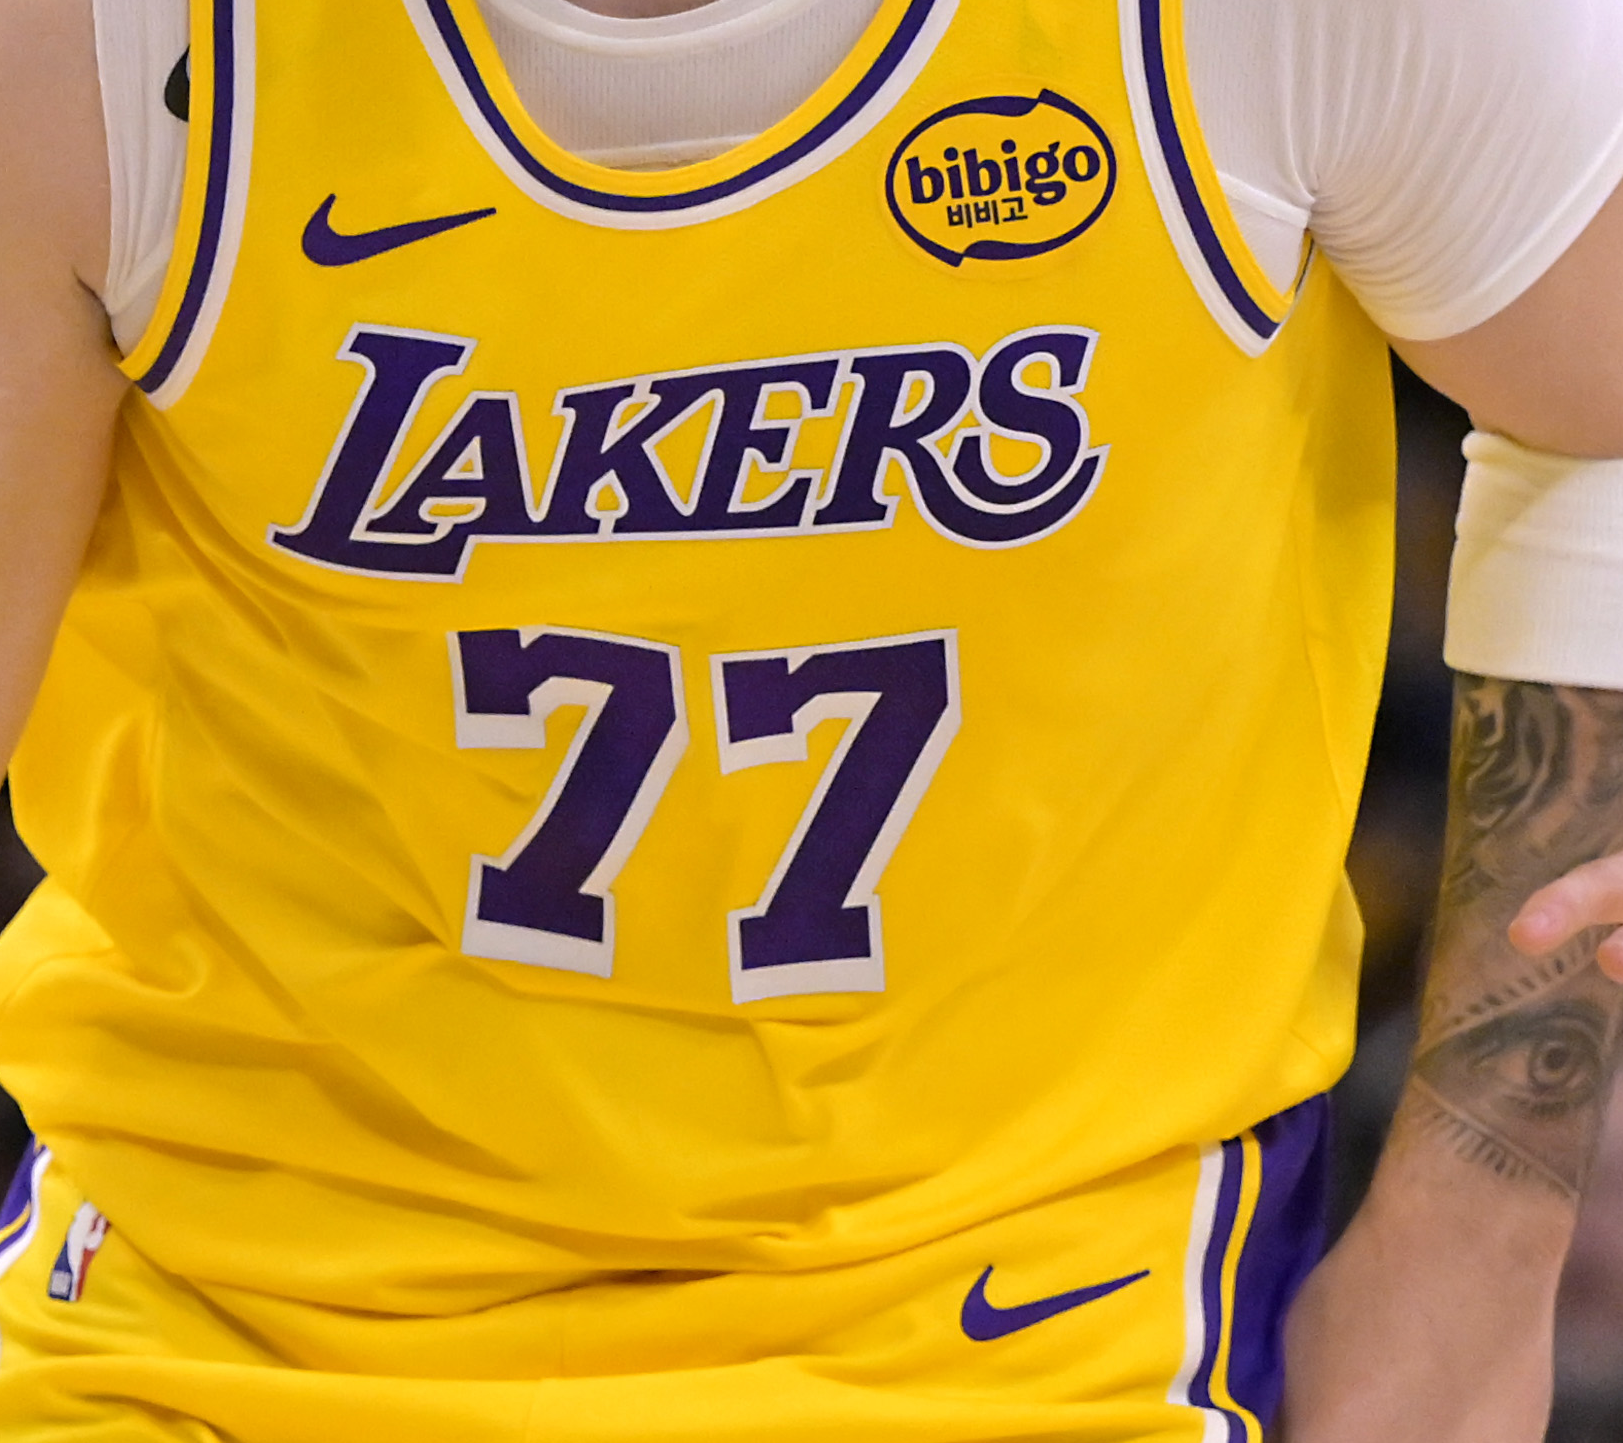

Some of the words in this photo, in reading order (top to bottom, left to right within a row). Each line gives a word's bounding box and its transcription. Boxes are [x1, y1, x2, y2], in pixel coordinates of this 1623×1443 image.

[904, 139, 1101, 206] bibigo
[946, 197, 1029, 229] 비비고
[265, 321, 1110, 584] LAKERS
[447, 625, 963, 1004] 77
